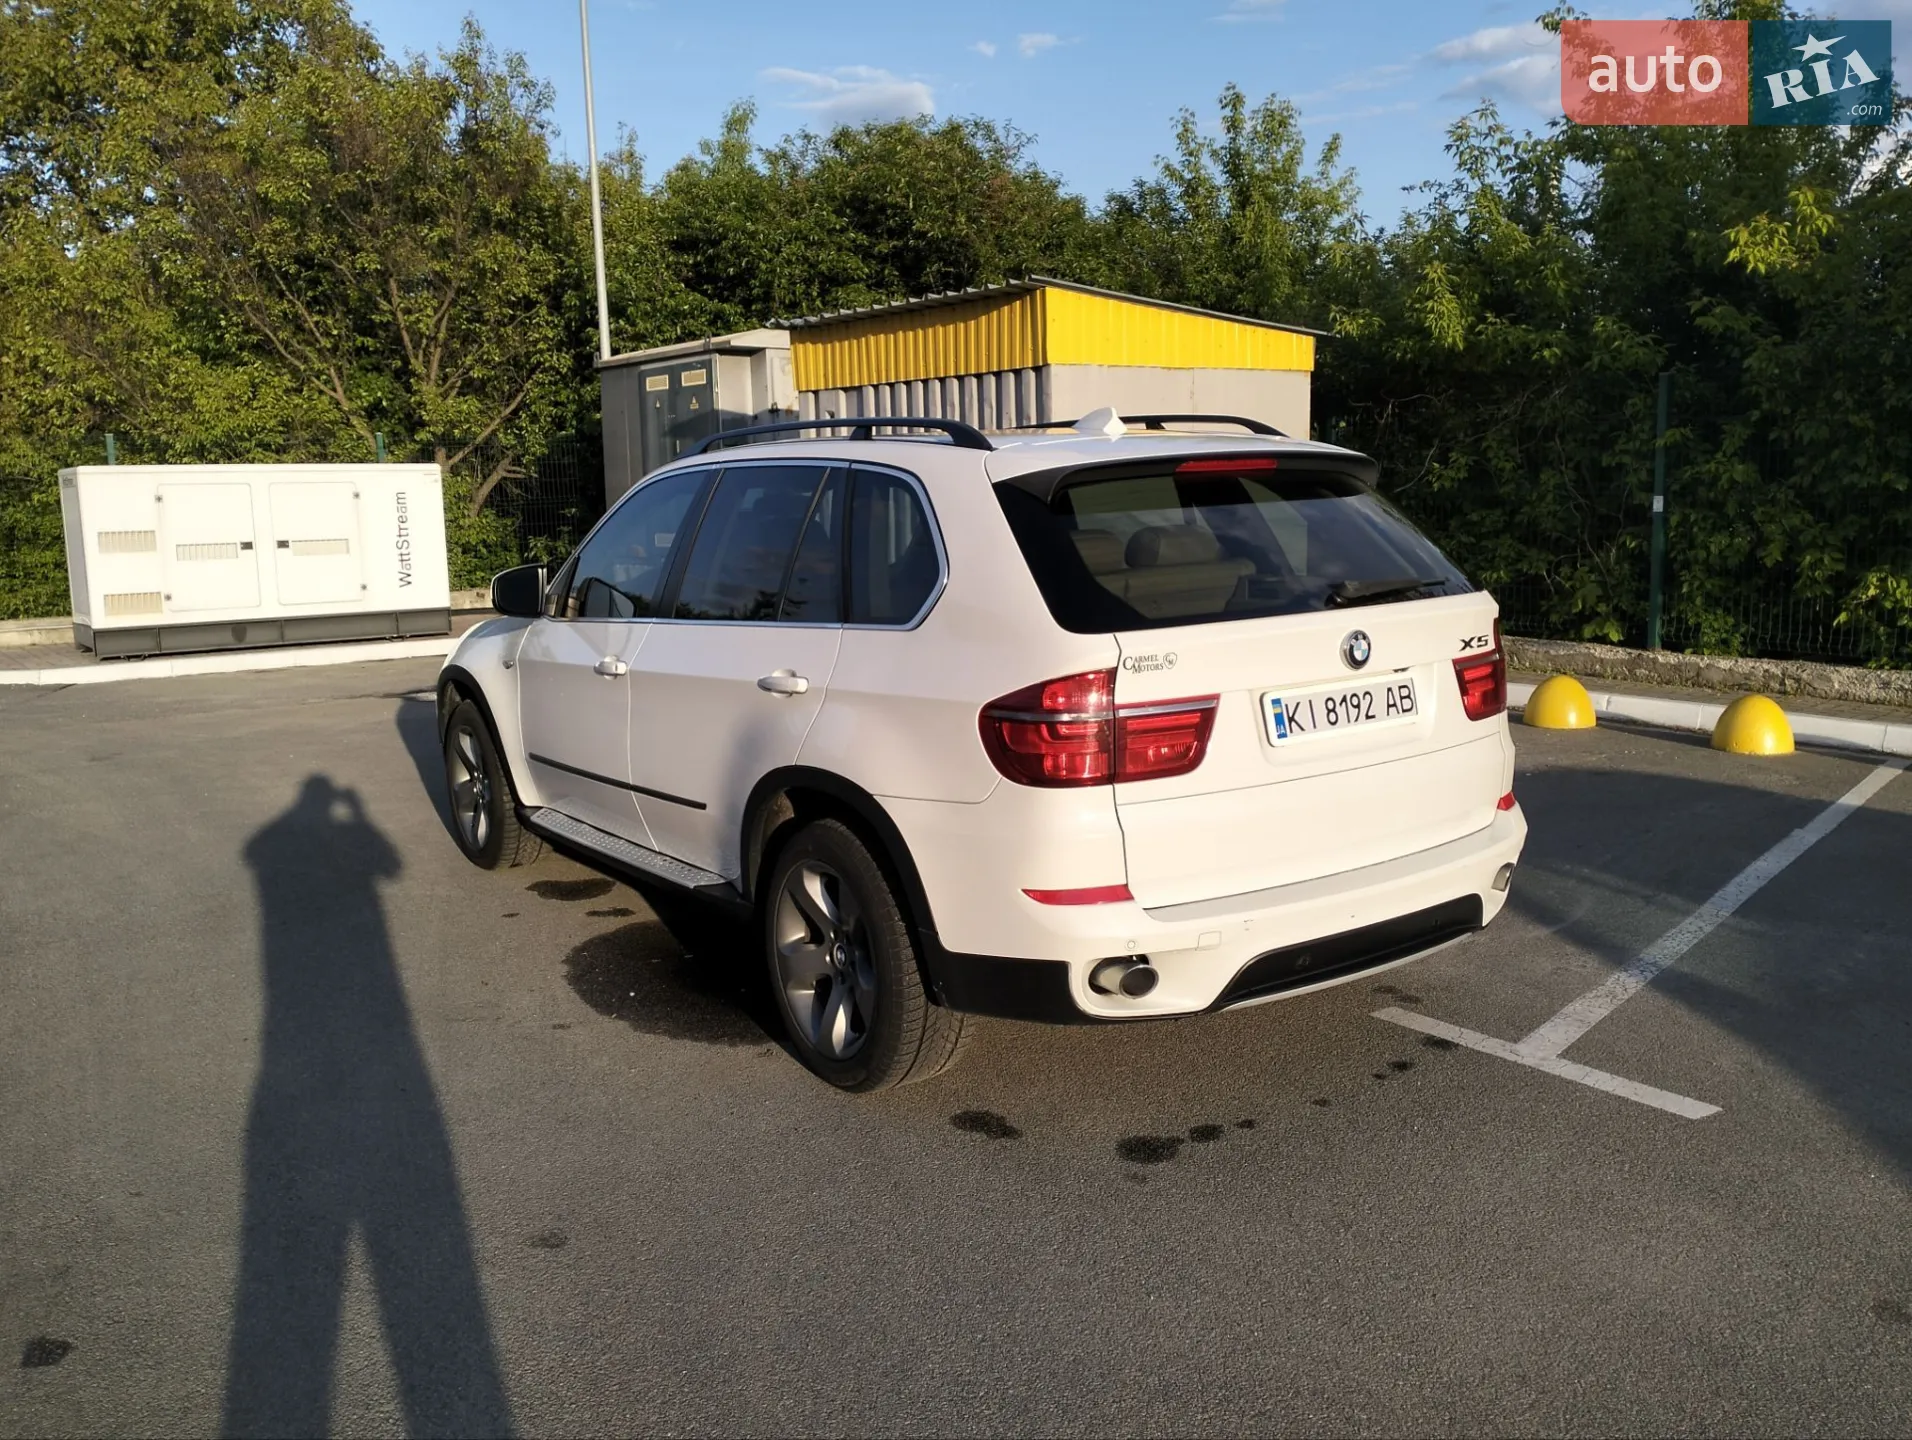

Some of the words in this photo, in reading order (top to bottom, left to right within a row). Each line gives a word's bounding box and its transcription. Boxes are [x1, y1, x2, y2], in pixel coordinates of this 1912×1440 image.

[396, 491, 412, 588] WattStream
[1459, 634, 1489, 651] X5
[1122, 654, 1159, 671] CARMEL
[1132, 662, 1164, 674] MOTORS
[1324, 690, 1376, 726] 8192
[1386, 684, 1414, 716] AB
